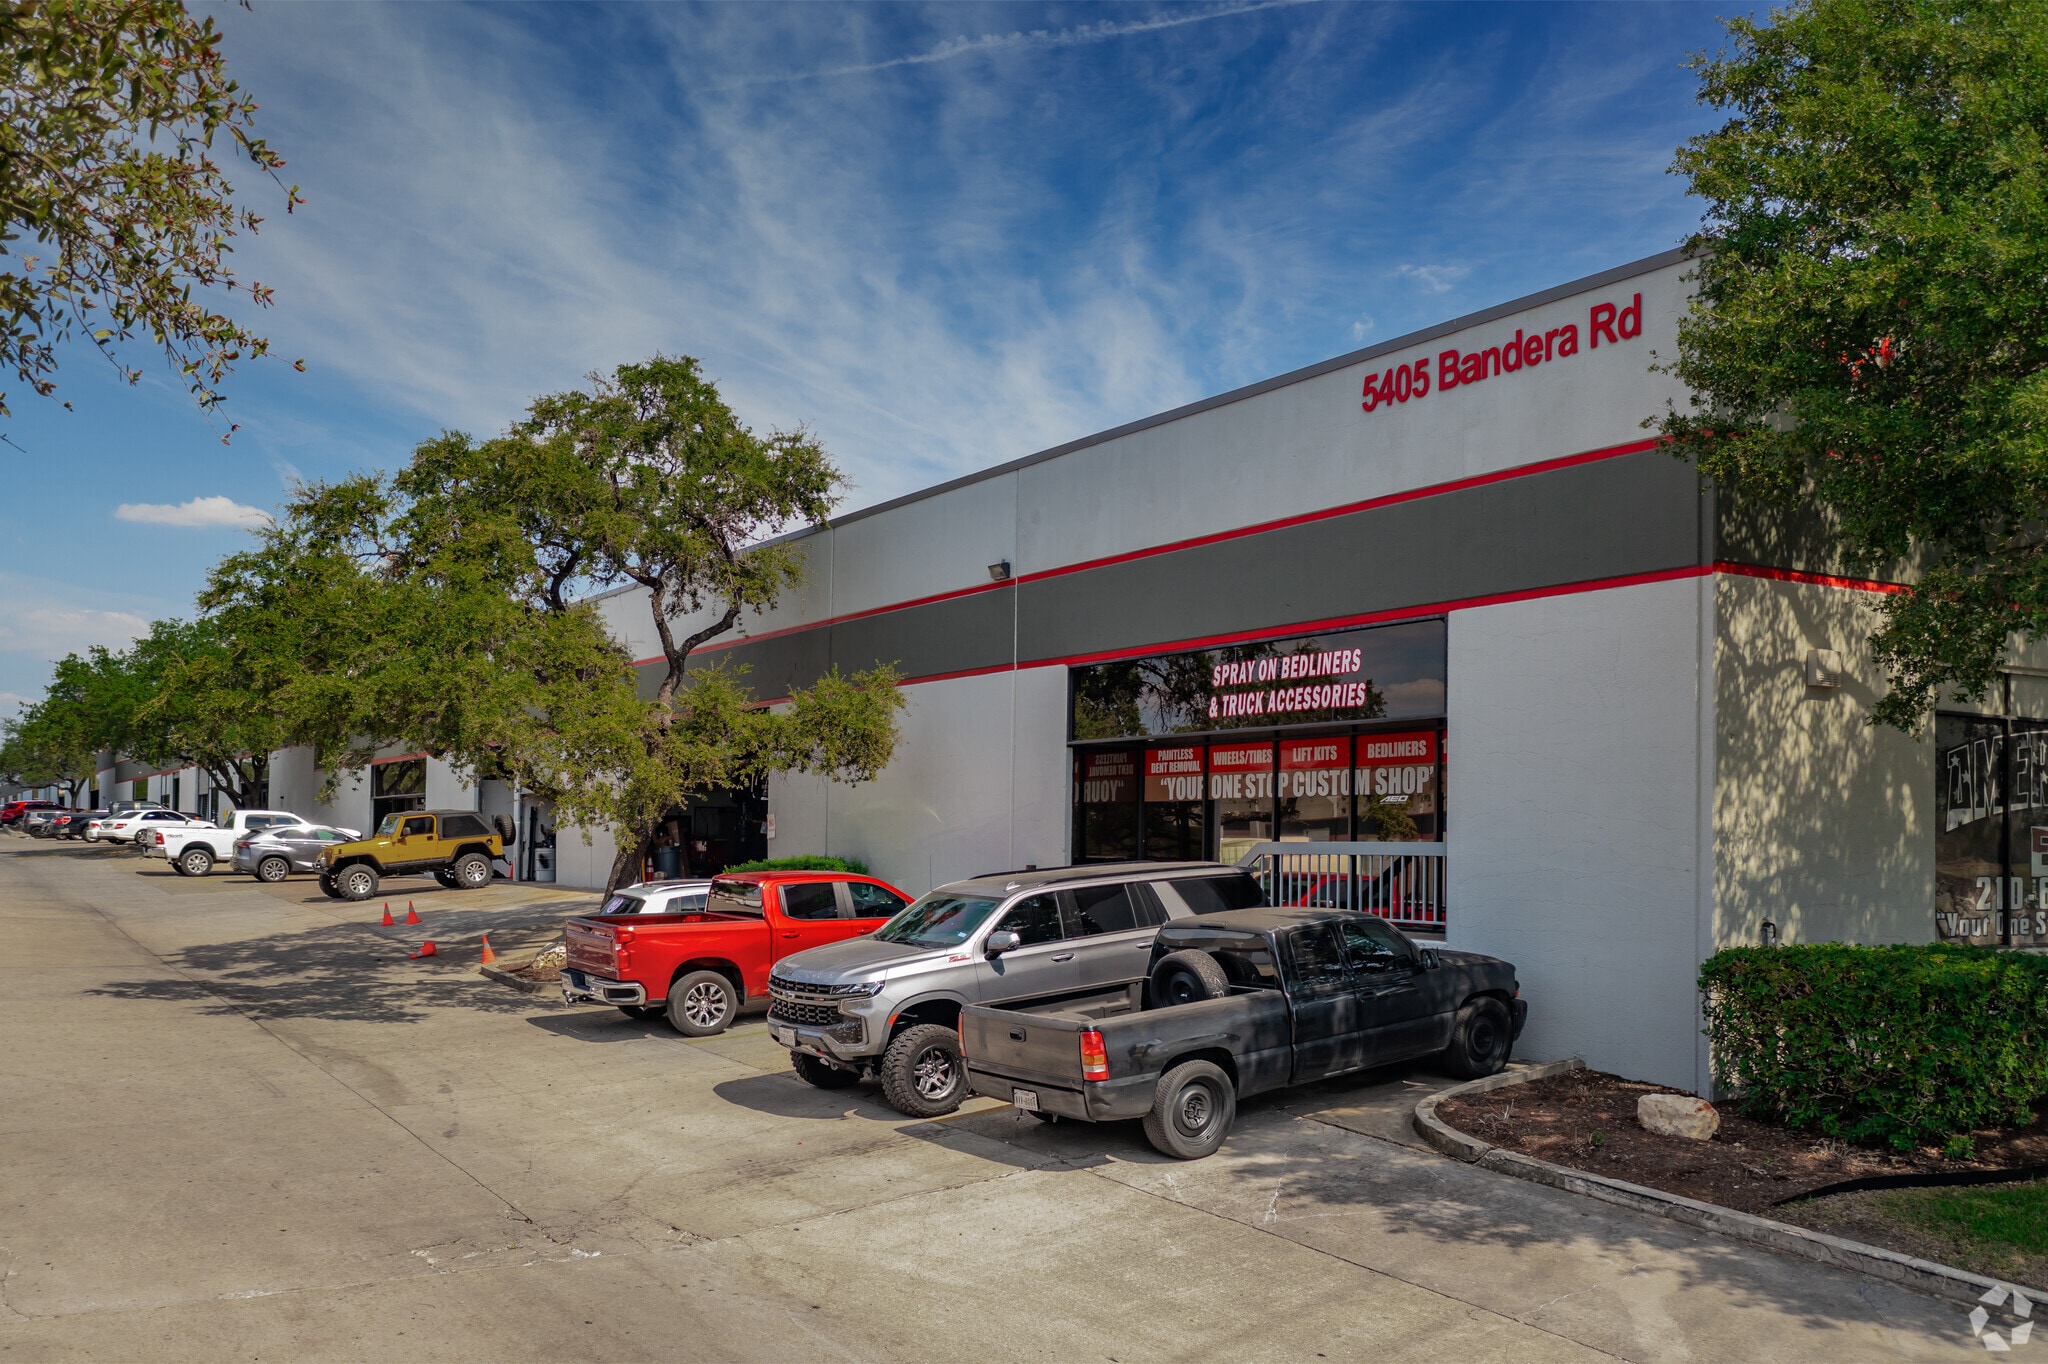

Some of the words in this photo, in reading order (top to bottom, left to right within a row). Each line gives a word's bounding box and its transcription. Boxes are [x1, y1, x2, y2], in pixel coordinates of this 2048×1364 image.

[1361, 358, 1430, 412] 5405
[1438, 324, 1578, 391] Bandera
[1590, 292, 1641, 349] Rd
[1212, 660, 1255, 687] SPRAY
[1258, 657, 1278, 681] ON
[1281, 648, 1362, 679] BEDLINERS
[1208, 696, 1218, 718] &
[1222, 691, 1264, 717] TRUCK
[1267, 682, 1366, 712] ACCESSORIES
[1158, 749, 1193, 761] PAINTLESS
[1213, 749, 1272, 766] WHEELS/TIRES
[1293, 747, 1312, 762] LIFT
[1314, 745, 1337, 761] KITS
[1367, 740, 1427, 759] BEDLINERS
[1151, 762, 1168, 773] DENT
[1169, 760, 1200, 772] REMOVAL
[1211, 774, 1241, 799] ONE
[1292, 768, 1370, 797] CUSTOM
[1995, 911, 2030, 936] One
